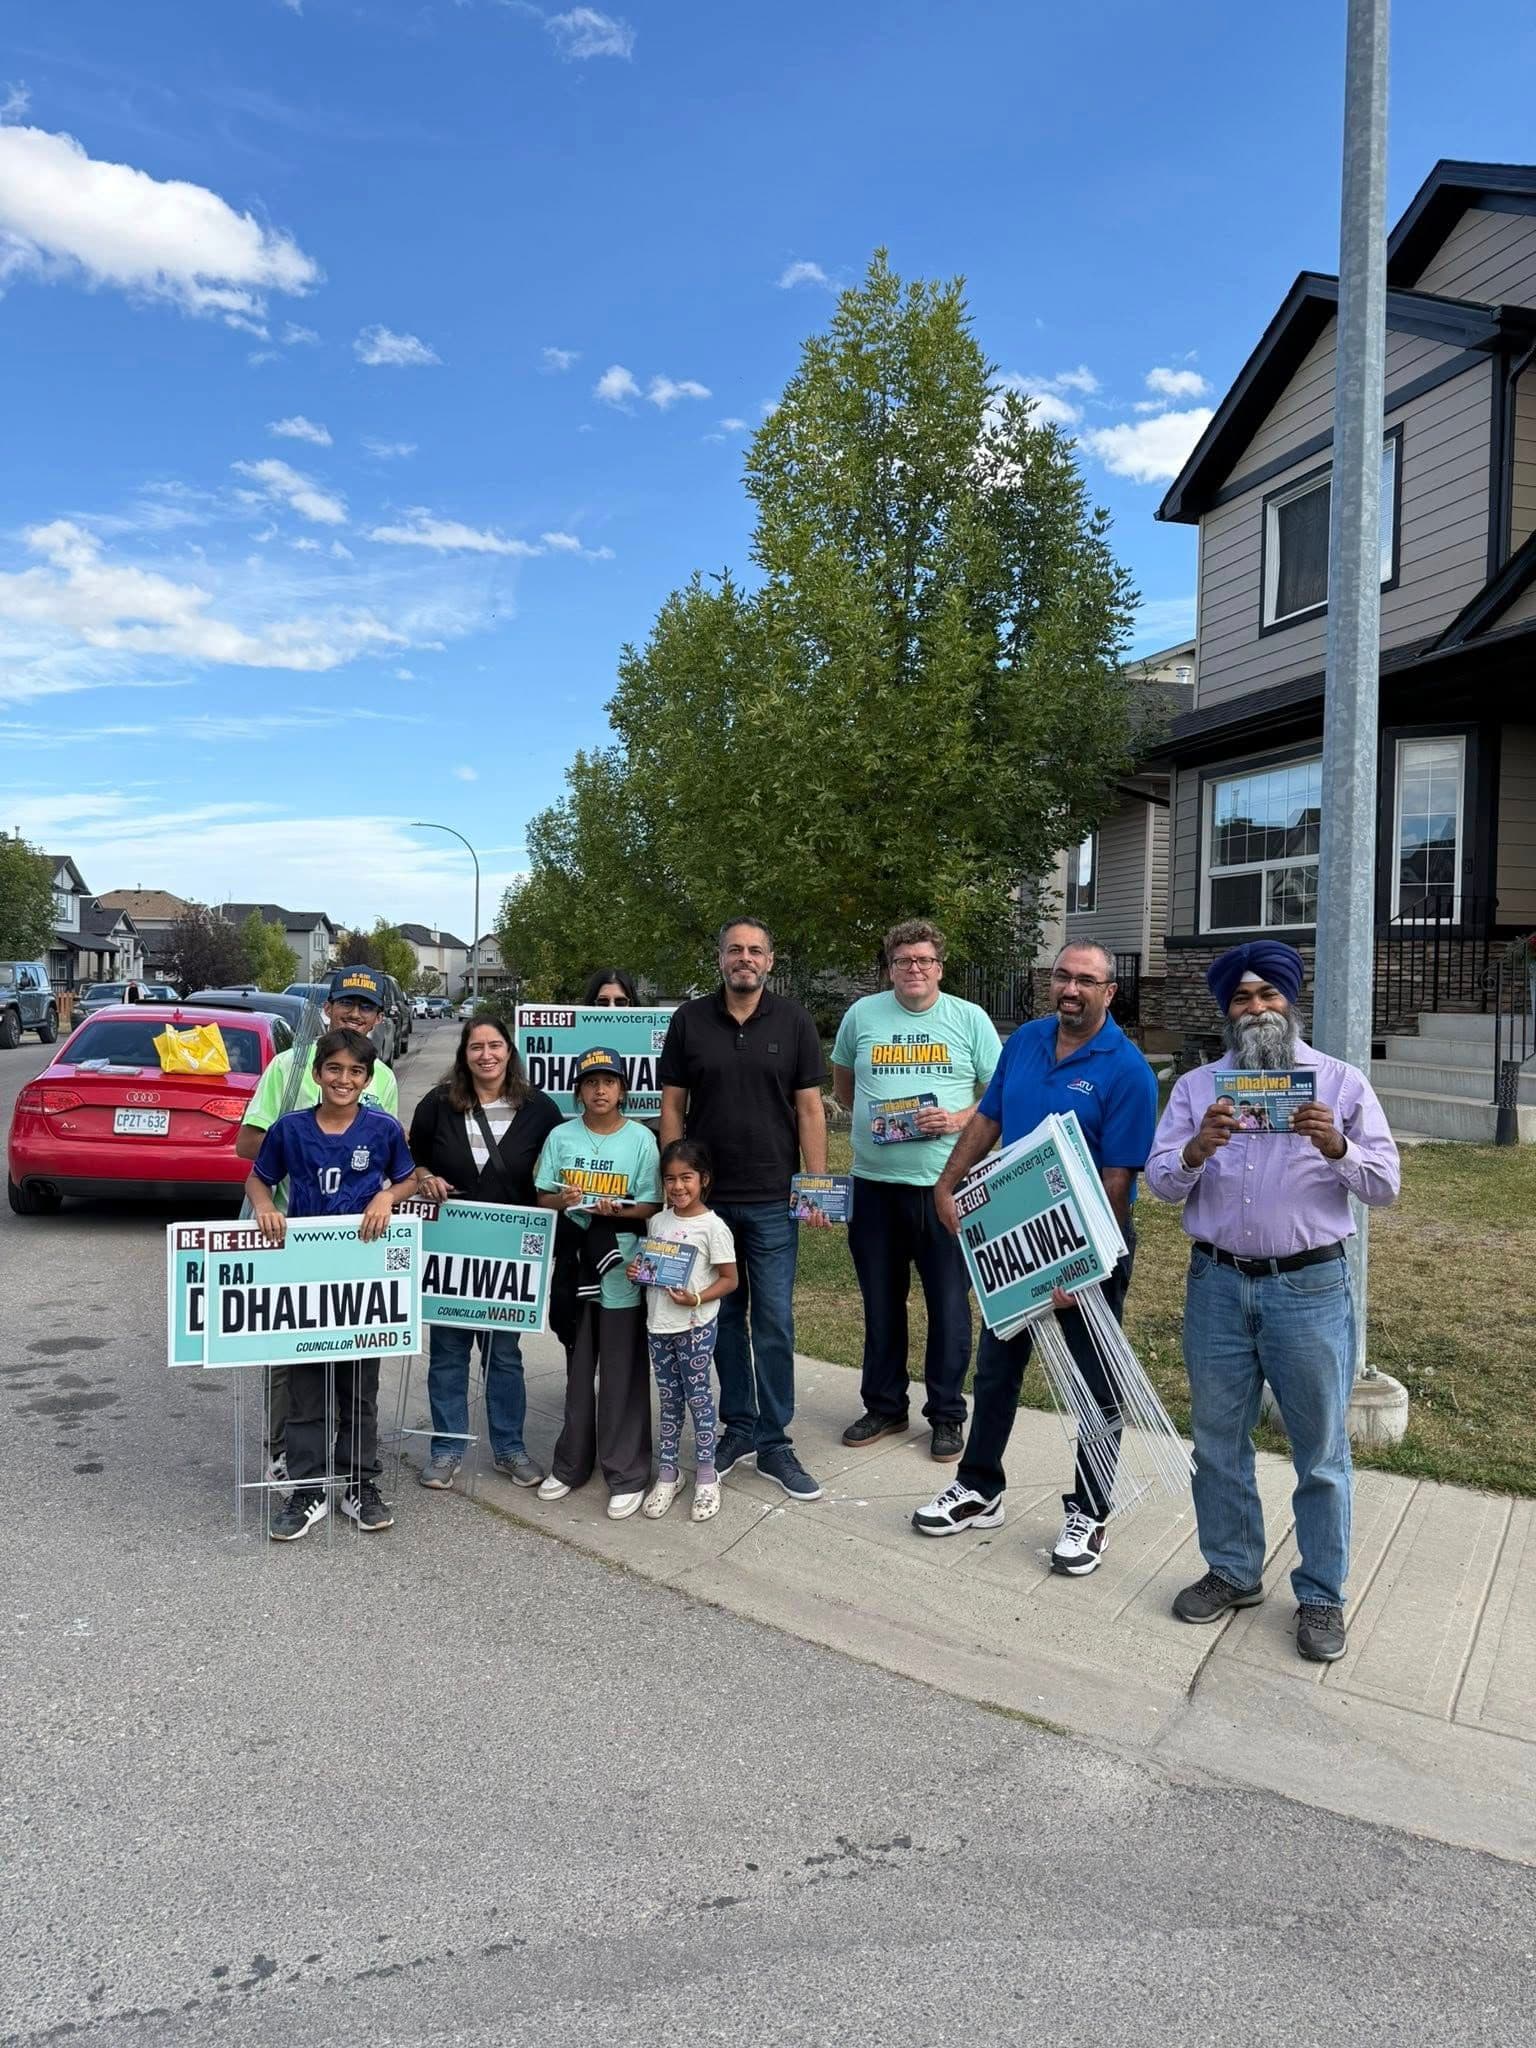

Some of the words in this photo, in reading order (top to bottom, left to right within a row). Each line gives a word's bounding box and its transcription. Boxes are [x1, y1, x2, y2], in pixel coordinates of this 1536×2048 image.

[522, 1012, 573, 1025] RE-ELECT
[582, 1014, 671, 1026] www.voteraj.ca
[526, 1036, 553, 1053] RAJ
[872, 1043, 951, 1064] DHALIWAL
[872, 1066, 911, 1075] WORKING
[916, 1066, 931, 1074] FOR
[1237, 1075, 1291, 1090] Dhaliwal
[629, 1098, 661, 1109] WARD
[989, 1146, 1055, 1192] www.voteraj.ca
[446, 1208, 547, 1228] www.voteraj.ca
[965, 1221, 987, 1250] RAJ
[974, 1203, 1087, 1293] DHALIWAL
[219, 1262, 254, 1286] RAJ
[422, 1254, 536, 1303] ALIWAL
[1060, 1258, 1090, 1283] WARD
[1090, 1254, 1098, 1270] 5
[222, 1280, 408, 1334] DHALIWAL
[438, 1306, 487, 1319] COUNCILLOR
[488, 1307, 525, 1323] WARD
[528, 1311, 537, 1324] 5
[296, 1340, 353, 1353] COUNCILLOR
[354, 1332, 398, 1349] WARD
[402, 1331, 411, 1346] 5
